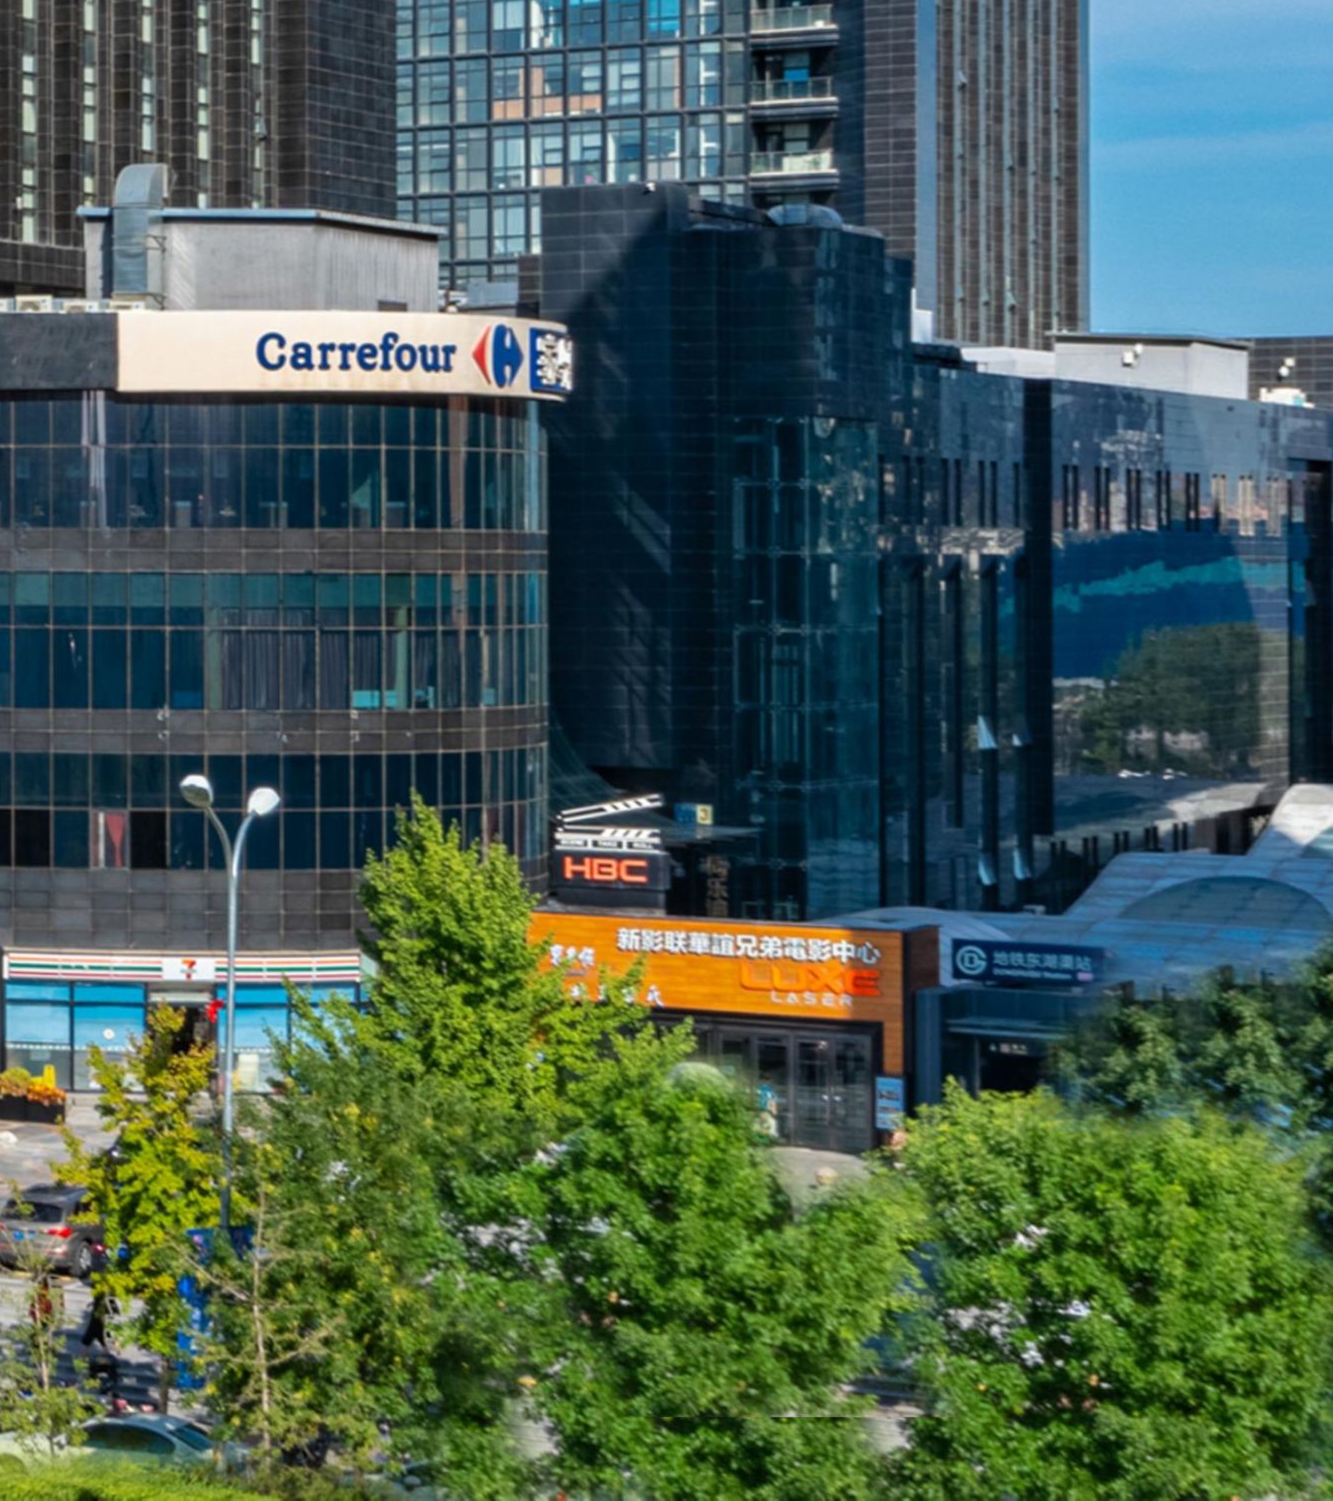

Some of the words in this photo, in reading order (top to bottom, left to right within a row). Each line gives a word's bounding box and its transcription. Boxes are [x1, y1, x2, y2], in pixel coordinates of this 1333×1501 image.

[255, 332, 457, 372] Carrefour
[563, 856, 648, 883] HBC
[739, 962, 880, 996] LUXE
[771, 990, 853, 1006] LASER
